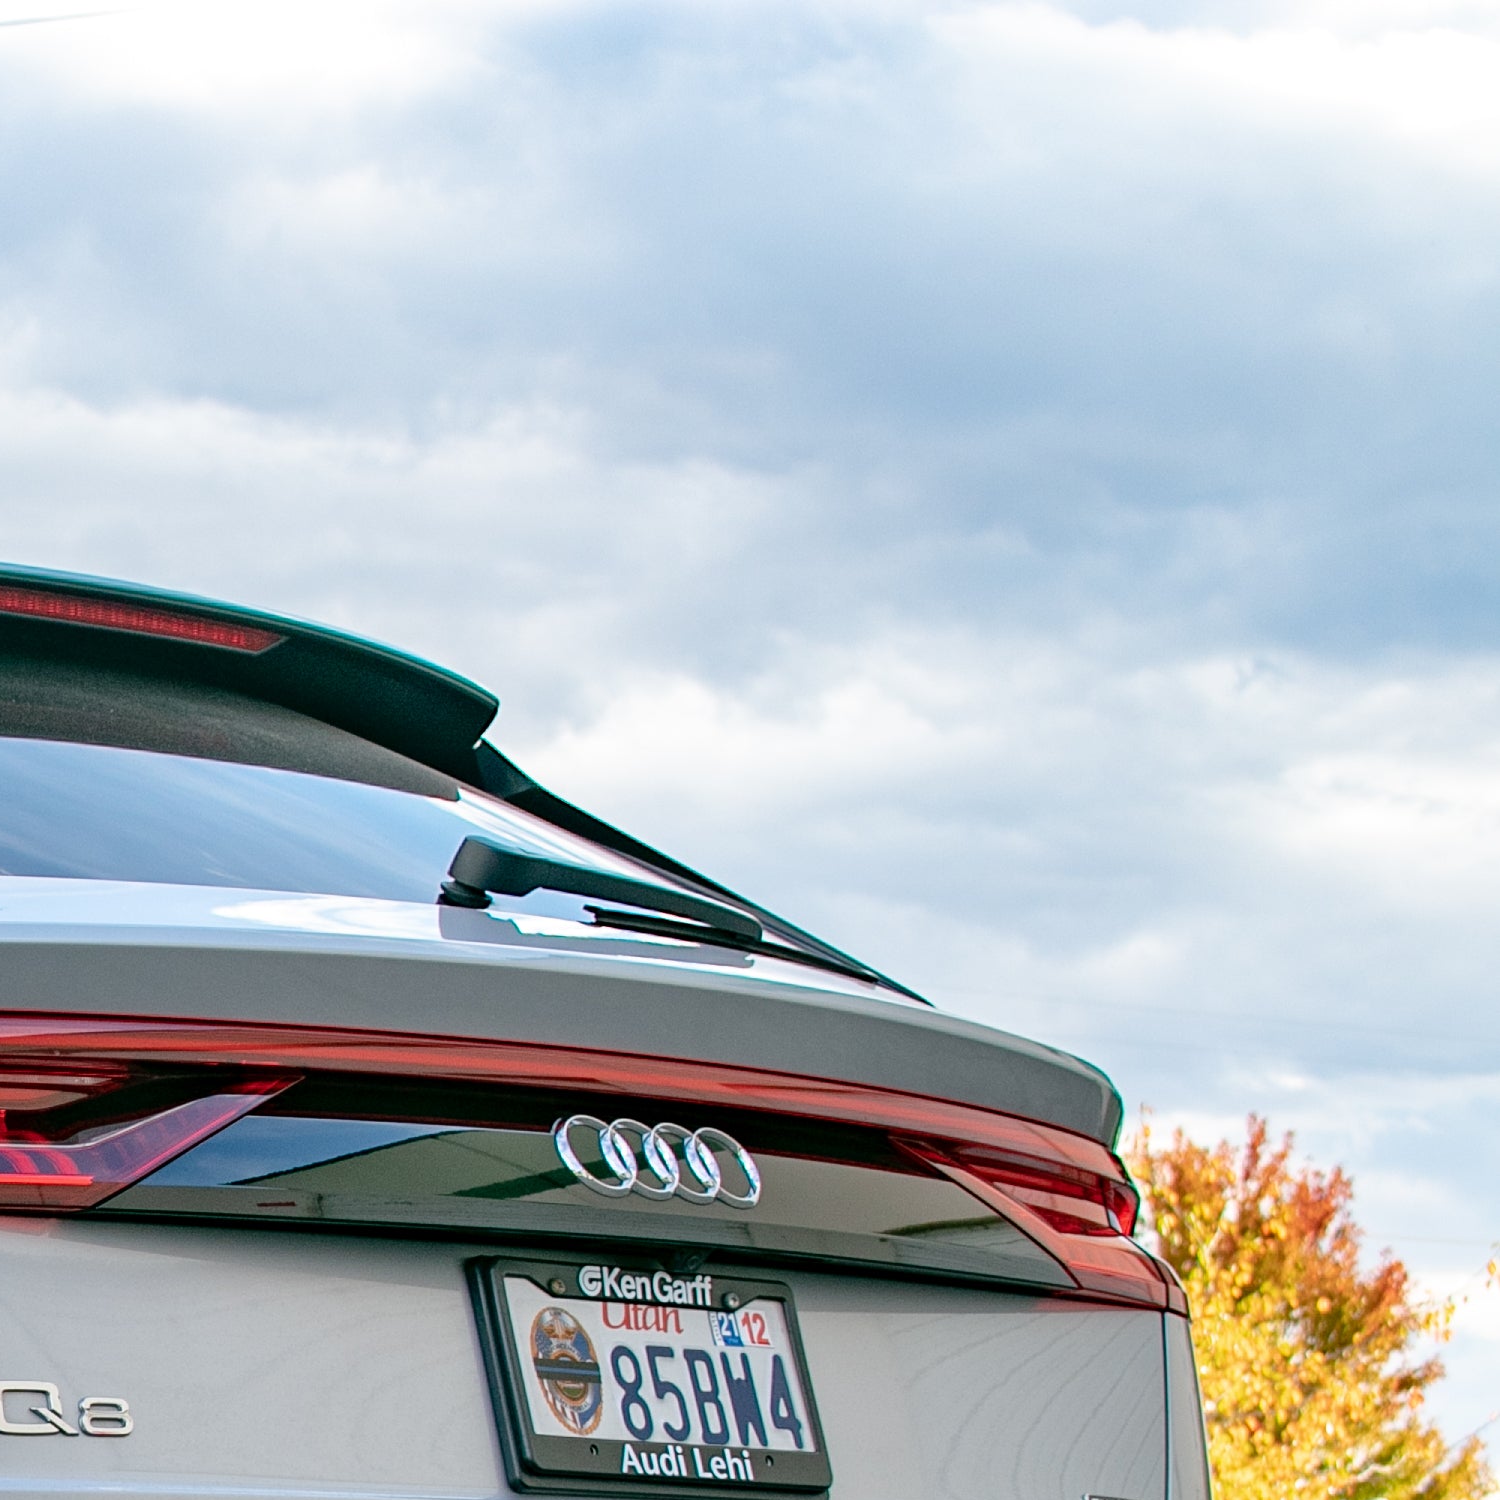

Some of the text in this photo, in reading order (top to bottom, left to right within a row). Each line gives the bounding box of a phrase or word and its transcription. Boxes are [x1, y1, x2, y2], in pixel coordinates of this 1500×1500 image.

[717, 1311, 740, 1338] 21
[741, 1311, 771, 1346] 12
[610, 1345, 804, 1450] 85BW4
[621, 1443, 755, 1482] Audi Lehi
